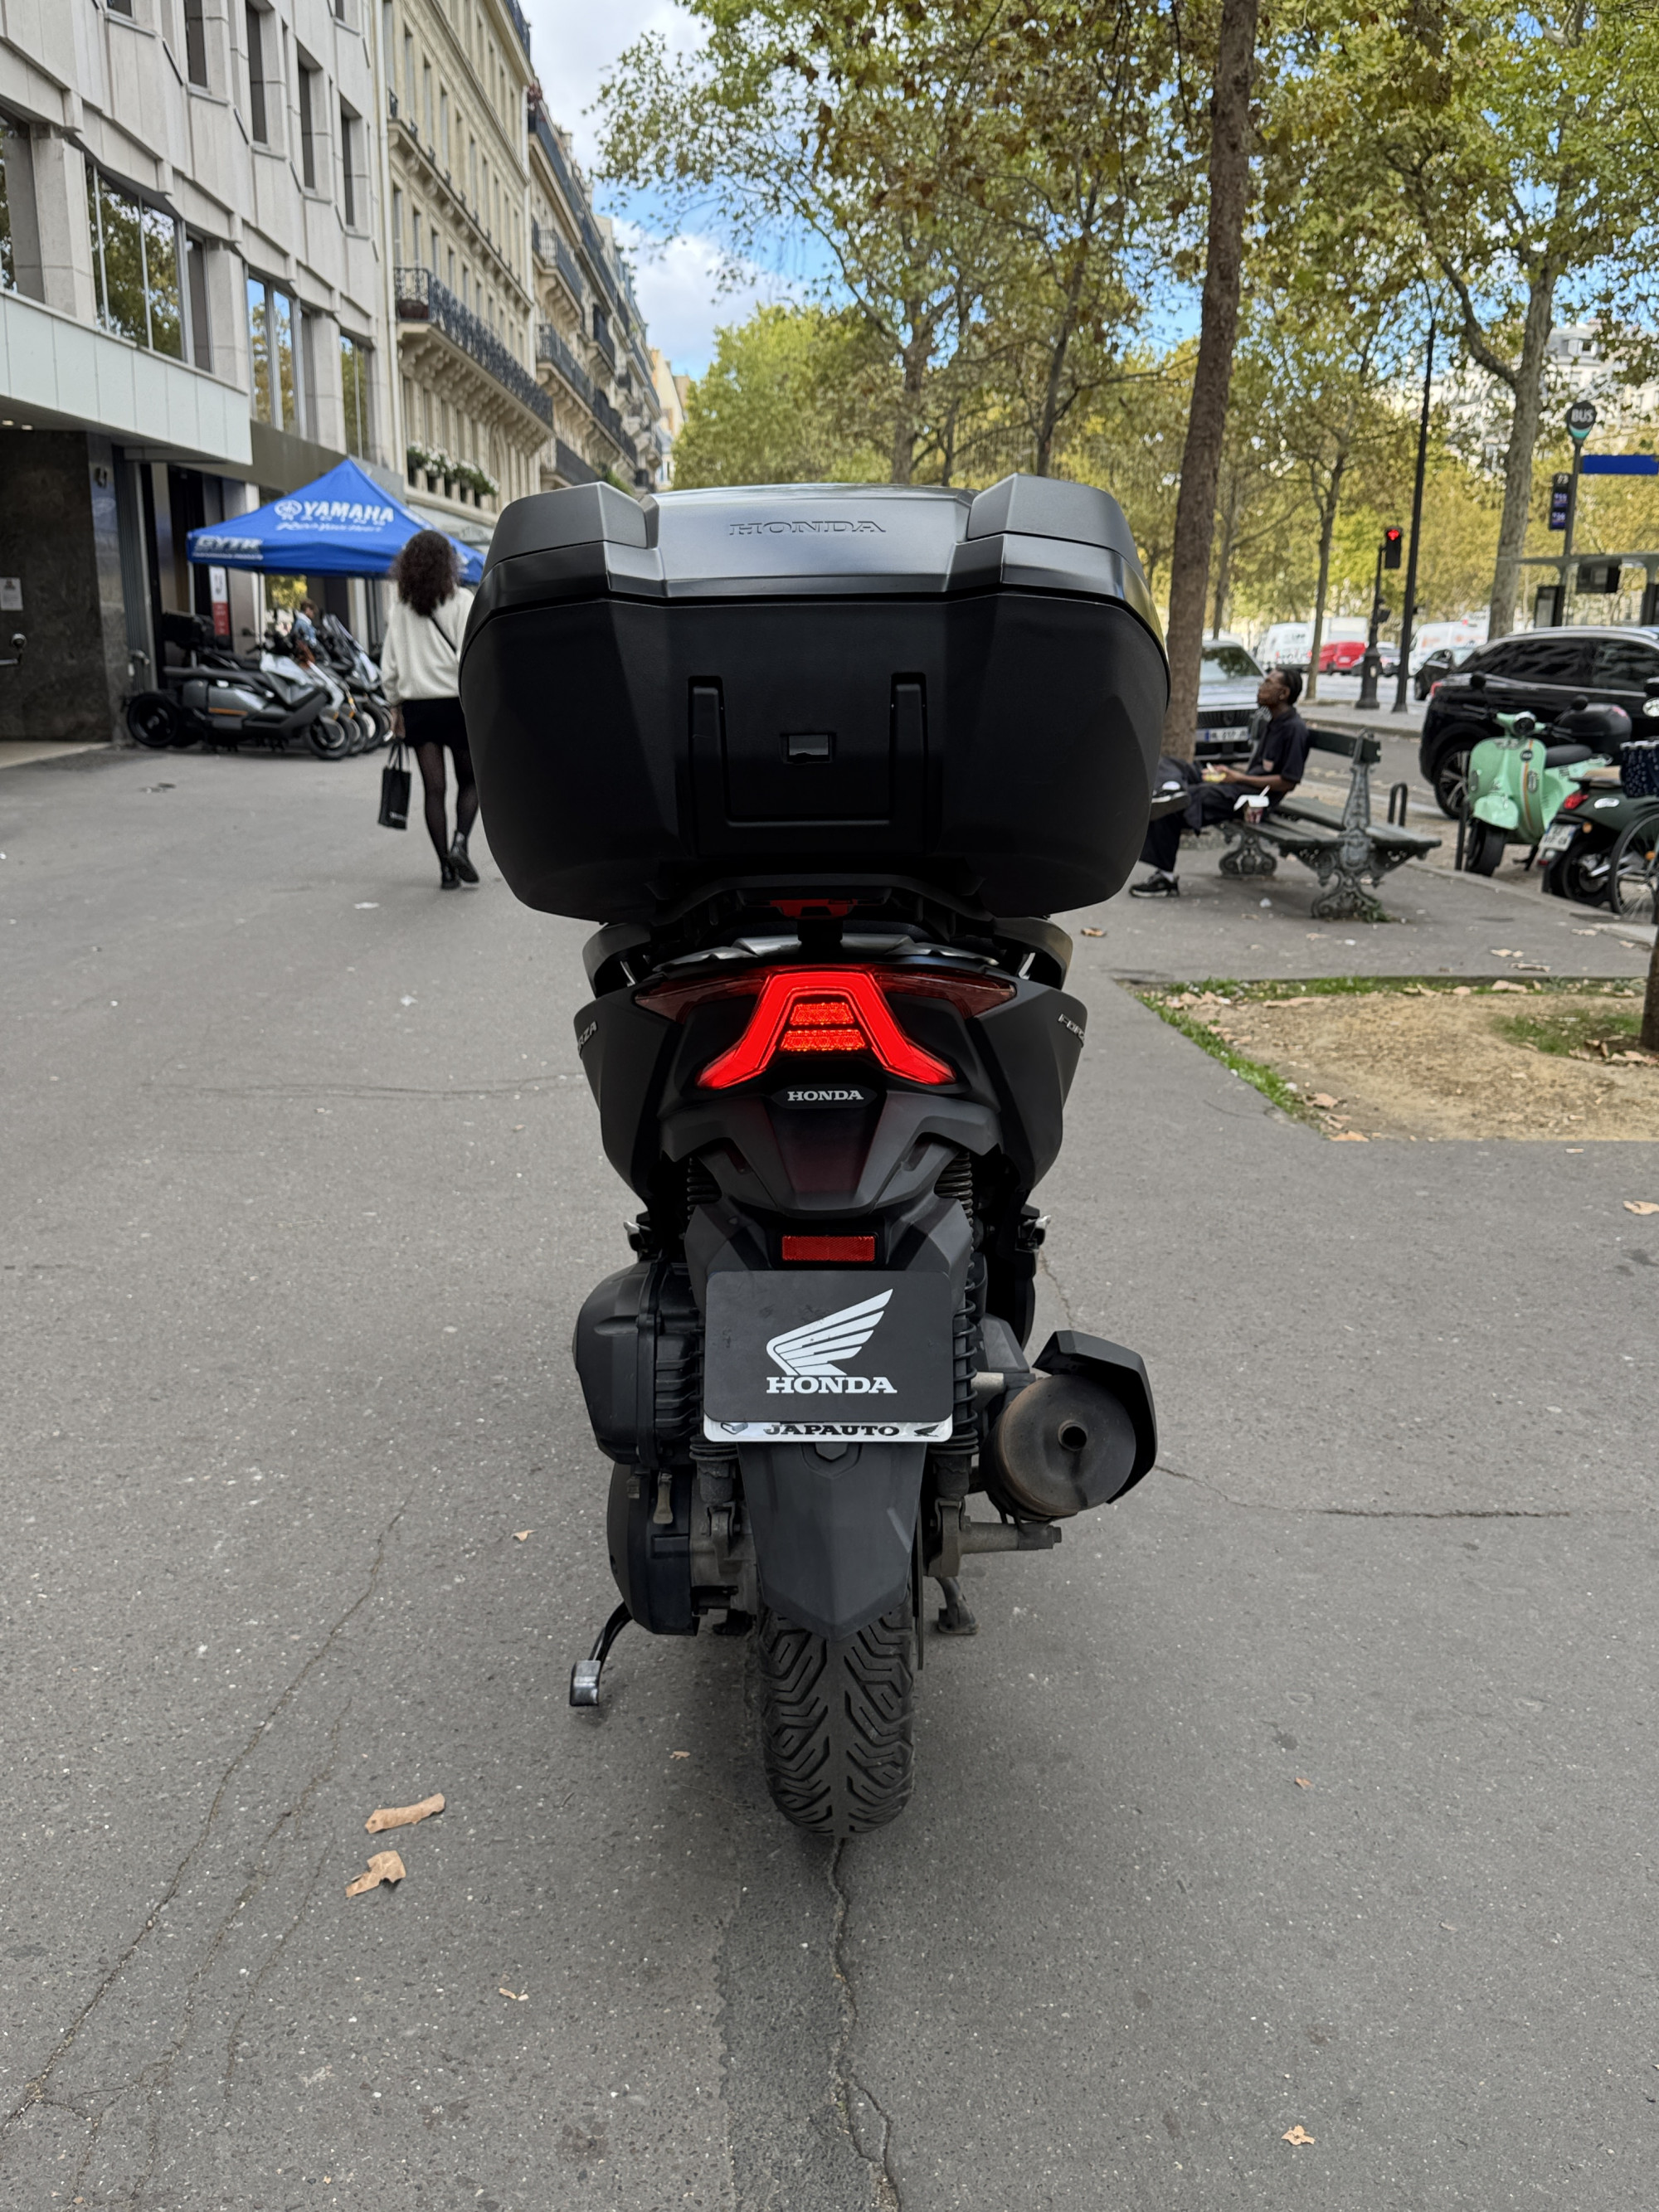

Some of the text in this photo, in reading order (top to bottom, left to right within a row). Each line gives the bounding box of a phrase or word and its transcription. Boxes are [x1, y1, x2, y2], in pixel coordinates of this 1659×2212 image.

[1571, 408, 1593, 423] BUS
[304, 501, 394, 523] YAMAHA
[729, 521, 887, 535] HONDA
[787, 1091, 864, 1101] HONDA
[766, 1377, 898, 1393] HONDA
[763, 1424, 900, 1436] JAPAUTO
